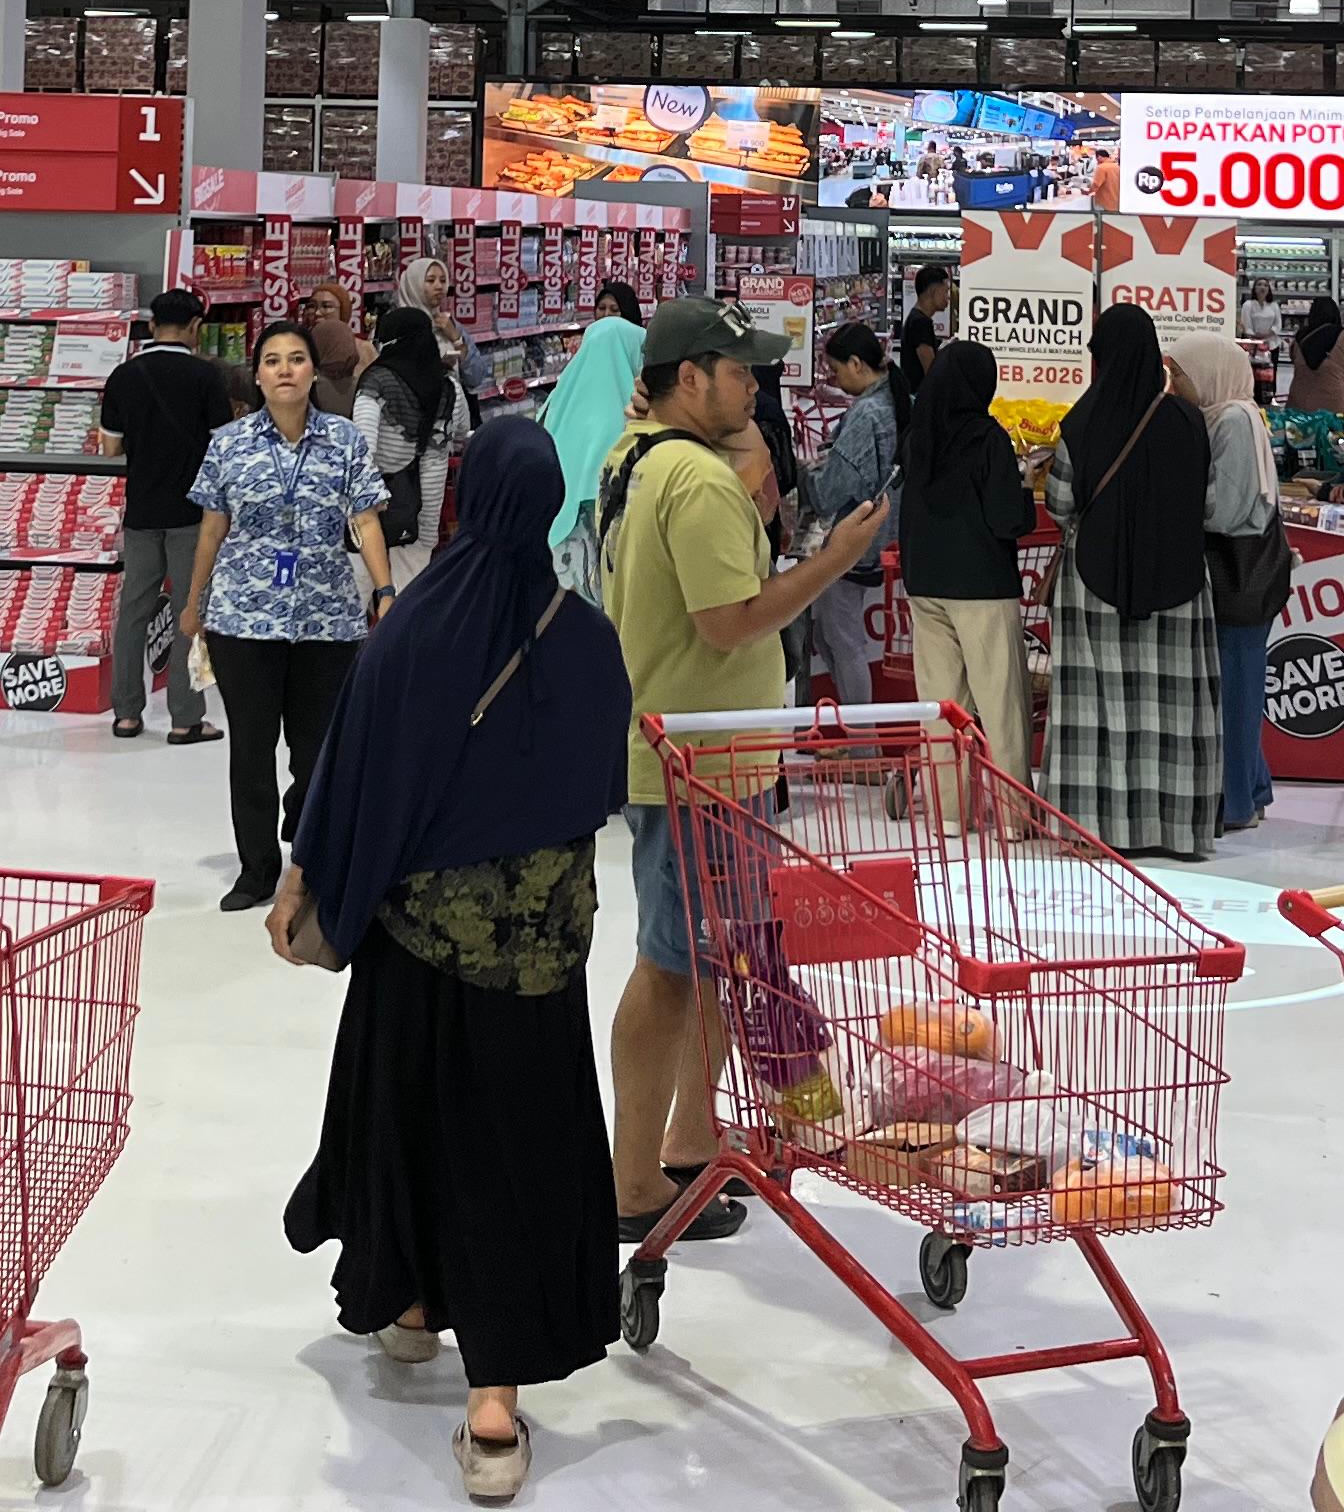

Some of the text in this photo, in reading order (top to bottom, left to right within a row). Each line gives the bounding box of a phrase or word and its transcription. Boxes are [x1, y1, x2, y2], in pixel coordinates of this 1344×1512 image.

[652, 90, 699, 117] New
[1145, 106, 1191, 119] Setiap
[1195, 106, 1295, 122] Pembelanjaan
[9, 129, 26, 137] Sale
[138, 106, 162, 142] 1
[1146, 122, 1286, 143] DAPATKAN
[6, 187, 24, 195] Sale
[1137, 170, 1161, 191] Rp
[782, 197, 796, 211] 17
[456, 224, 474, 319] BIGSALE
[499, 225, 520, 313] BIGSALE
[544, 226, 562, 310] BIGSALE
[578, 228, 598, 307] BIGSALE
[611, 230, 628, 284] GSALE
[639, 230, 655, 300] BIGSALE
[661, 231, 680, 299] BIGSALE
[265, 221, 291, 329] IGSALE
[740, 277, 785, 289] GRAND
[741, 288, 784, 297] RELAUNCH
[1111, 284, 1225, 314] GRATIS
[968, 295, 1083, 326] GRAND
[1175, 314, 1205, 324] Cooler
[1206, 315, 1225, 325] Bag
[968, 326, 1082, 346] RELAUNCH
[999, 364, 1084, 385] EB.2026
[146, 601, 174, 644] SAVE
[3, 656, 58, 689] SAVE
[7, 679, 66, 711] MORE
